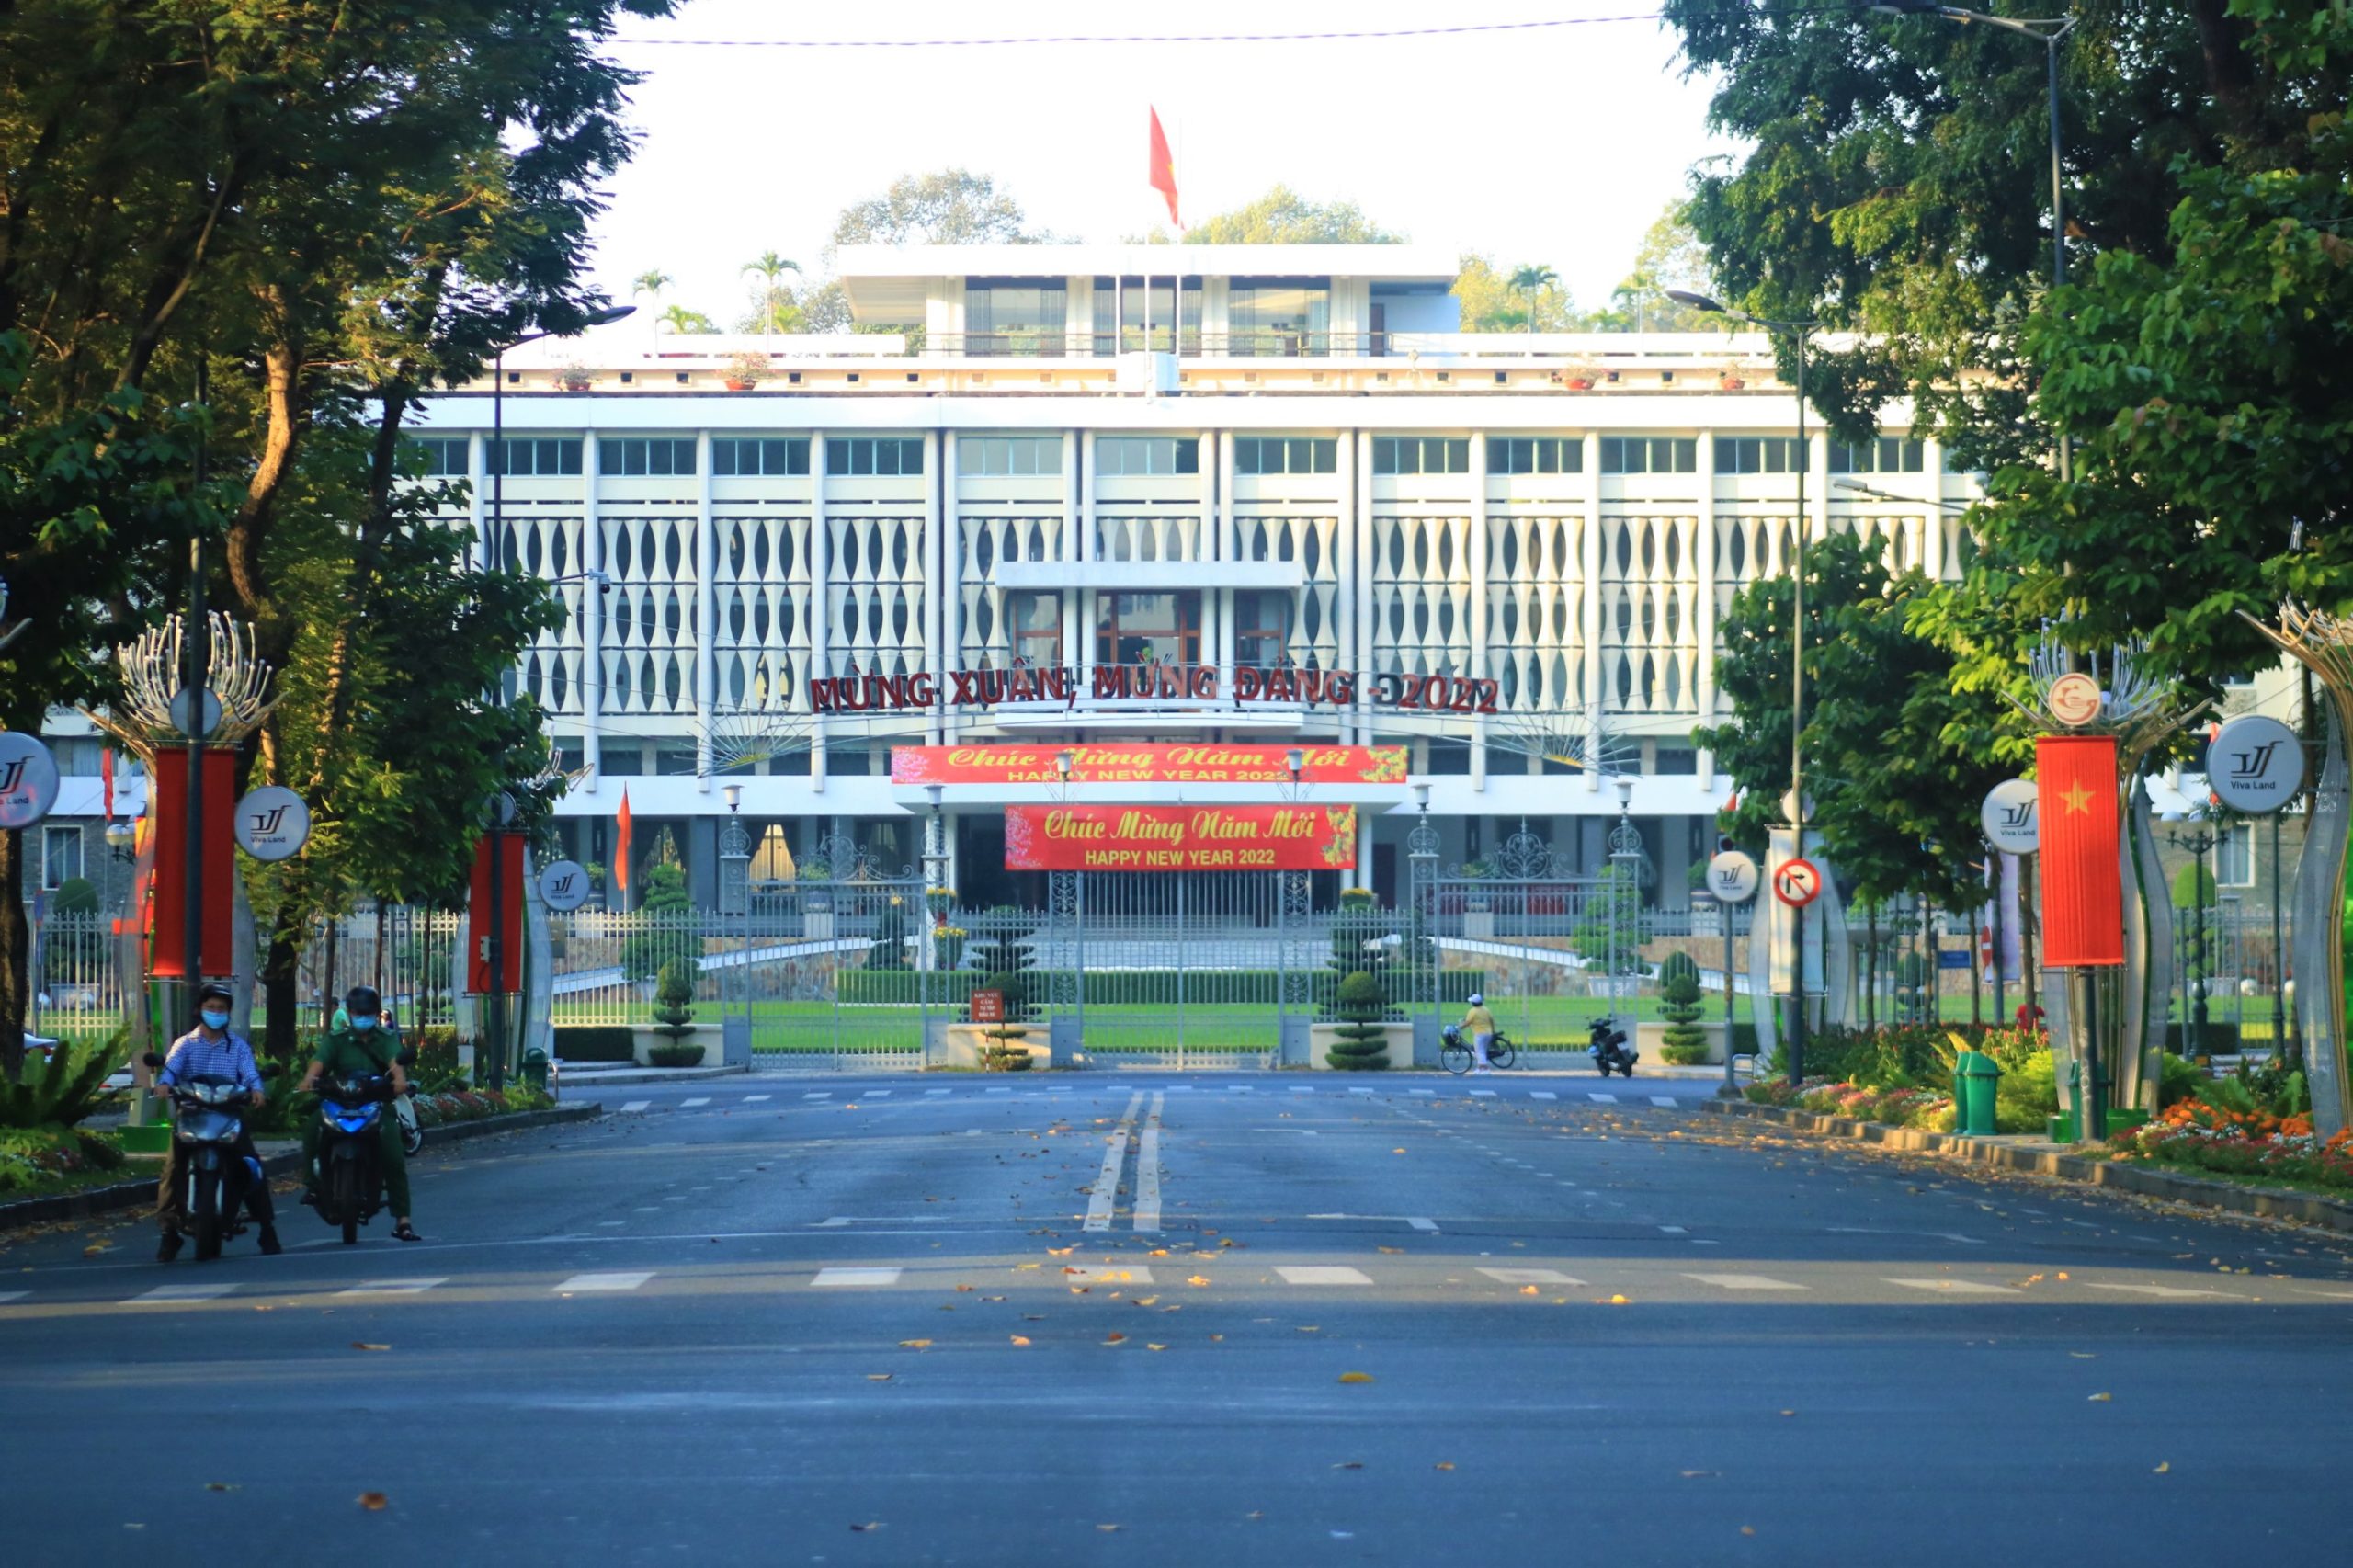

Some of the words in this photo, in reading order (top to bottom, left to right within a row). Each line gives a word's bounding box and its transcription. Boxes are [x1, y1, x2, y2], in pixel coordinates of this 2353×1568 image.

[810, 663, 935, 714] MỪNG
[949, 656, 1077, 710] XUÂN,
[1095, 651, 1219, 699] MỪNG
[1233, 655, 1352, 704] ĐẢNG
[1397, 673, 1499, 713] 2022
[948, 748, 1037, 767] Chúc
[1166, 746, 1265, 766] Năm
[1097, 770, 1154, 780] NEW
[1162, 770, 1228, 780] YEAR
[2230, 780, 2250, 790] Viva
[2253, 780, 2276, 790] Land
[6, 797, 29, 805] Land
[1044, 810, 1105, 839] Chúc
[1109, 810, 1186, 846] Mừng
[1191, 810, 1258, 839] Năm
[1262, 810, 1316, 839] Mới
[1085, 850, 1142, 866] HAPPY
[1146, 850, 1184, 866] NEW
[1188, 850, 1234, 865] YEAR
[1238, 849, 1276, 865] 2022
